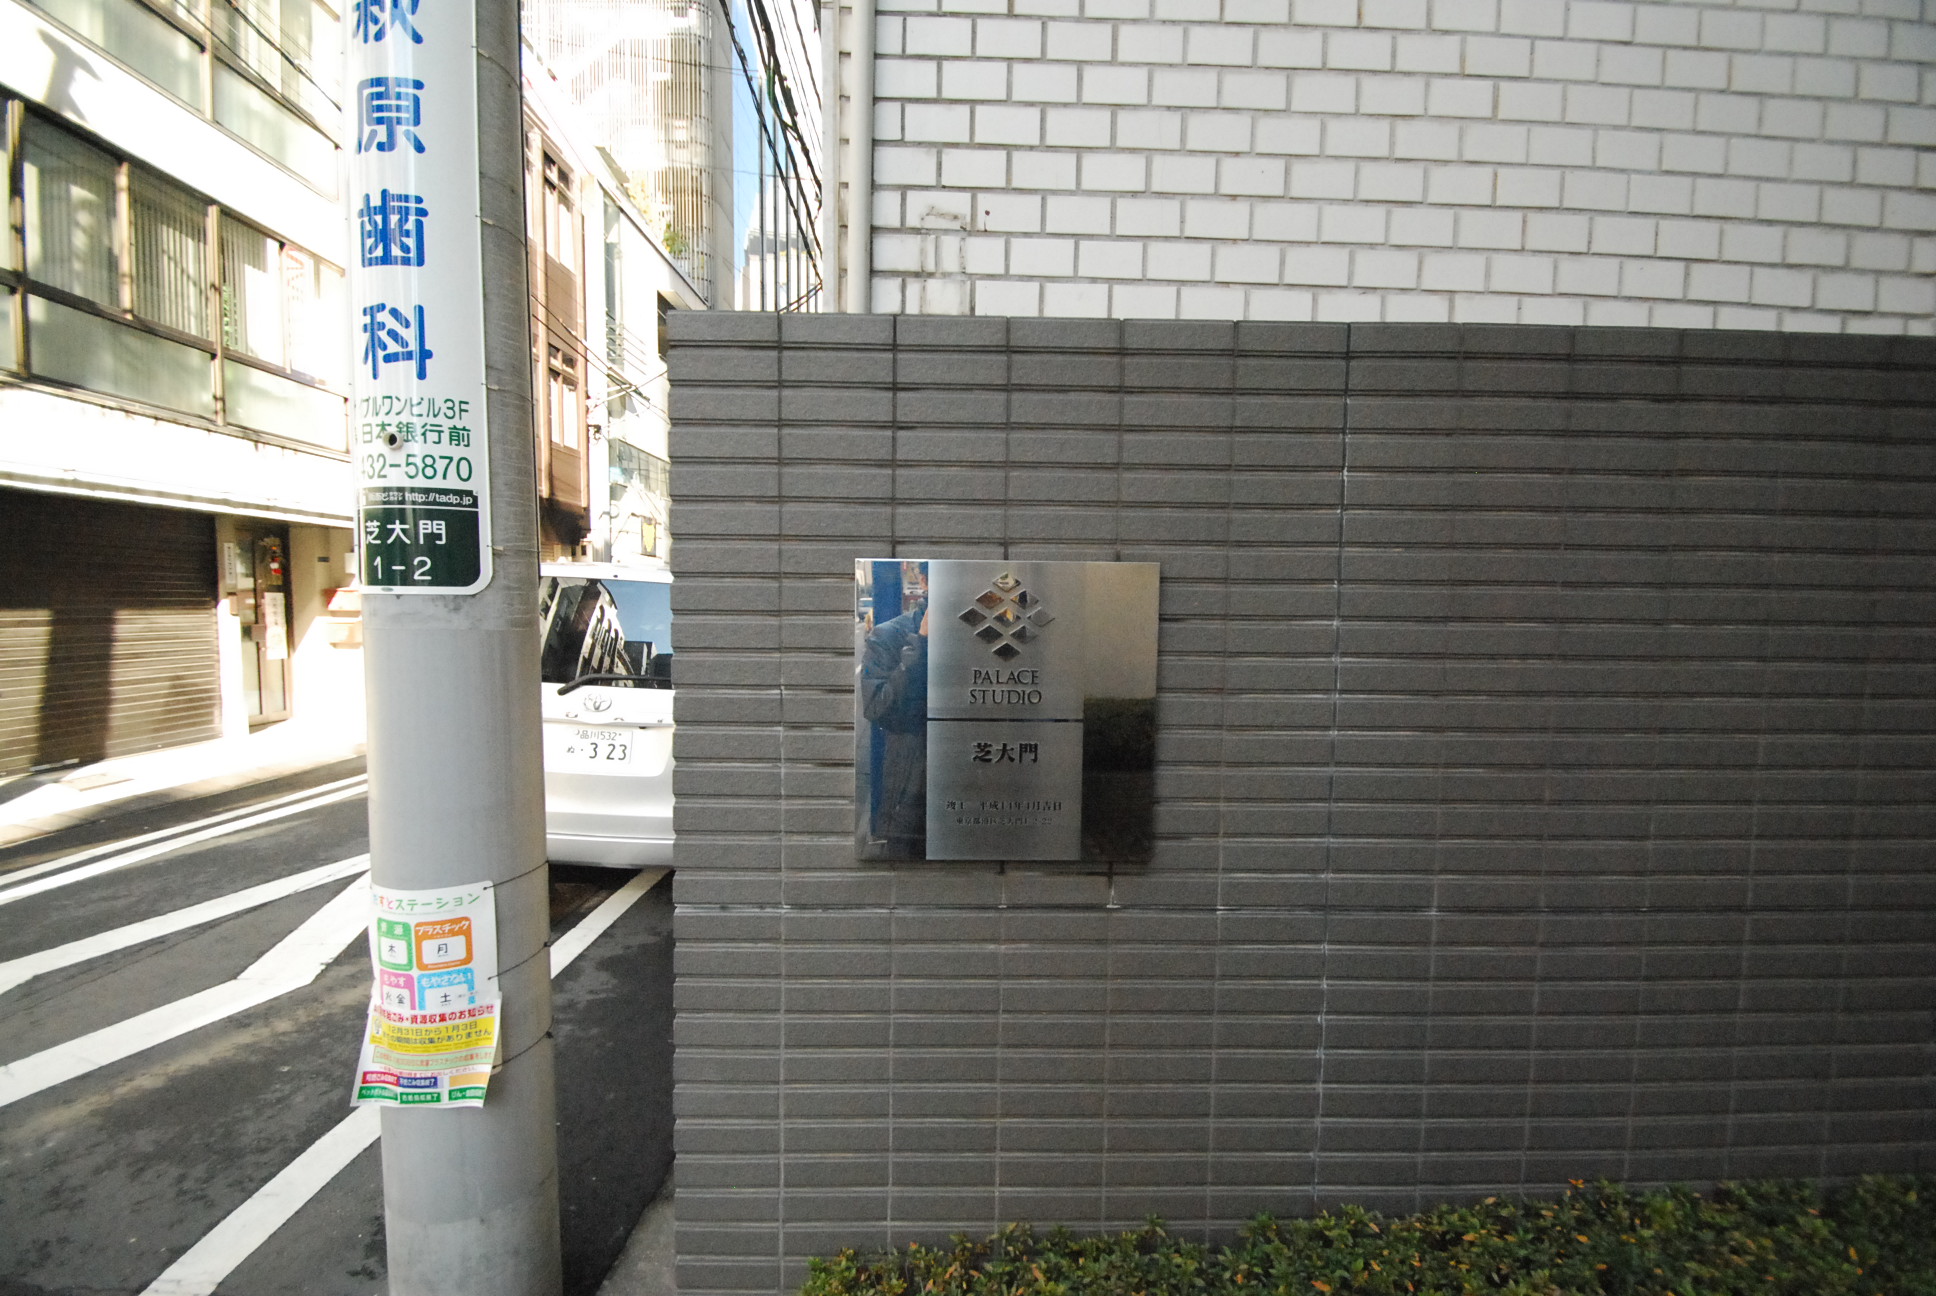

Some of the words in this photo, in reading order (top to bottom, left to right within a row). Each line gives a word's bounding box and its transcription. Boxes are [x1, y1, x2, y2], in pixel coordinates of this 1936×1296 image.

[355, 421, 471, 447] 日本銀行前
[405, 491, 473, 505] http://tadp.jp
[365, 520, 446, 544] 芝大門
[373, 556, 432, 580] 1-2
[972, 669, 1039, 684] PALACE
[969, 689, 1042, 704] STUDIO
[972, 742, 1039, 763] 芝大門
